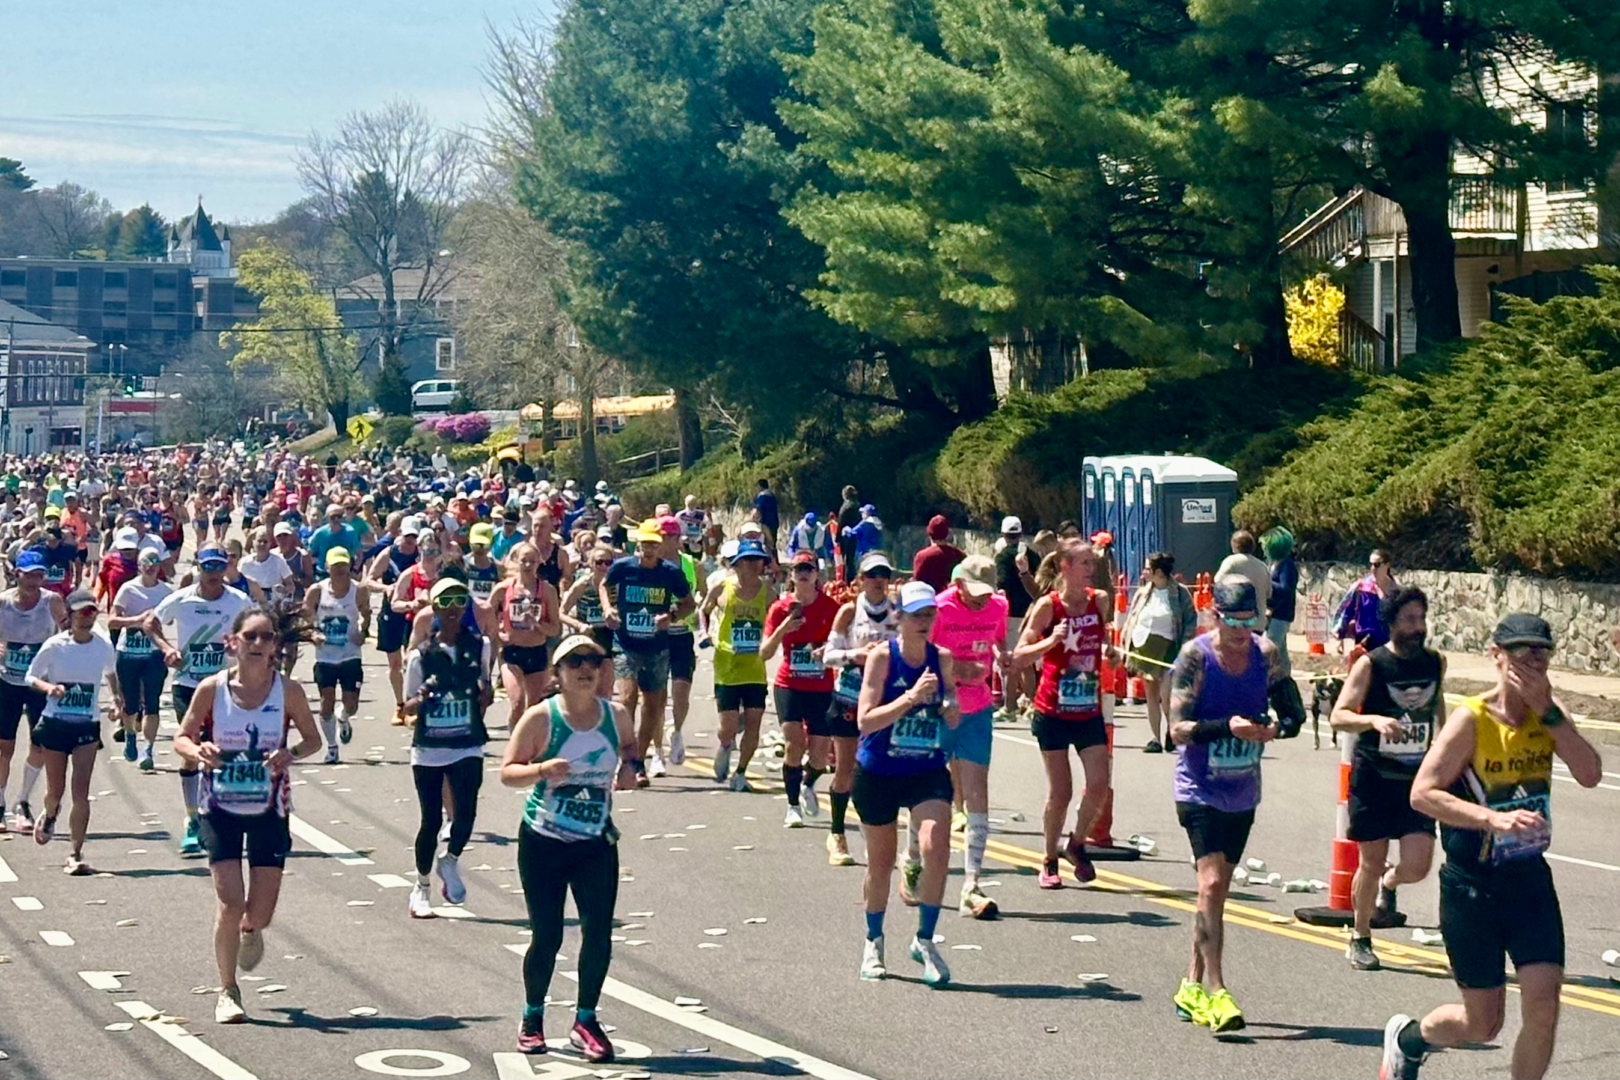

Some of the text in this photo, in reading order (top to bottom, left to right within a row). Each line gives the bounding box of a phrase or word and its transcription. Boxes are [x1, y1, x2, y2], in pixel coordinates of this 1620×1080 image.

[628, 614, 655, 627] 2371
[192, 652, 224, 667] 21407
[792, 651, 816, 664] 209
[1485, 758, 1503, 773] la
